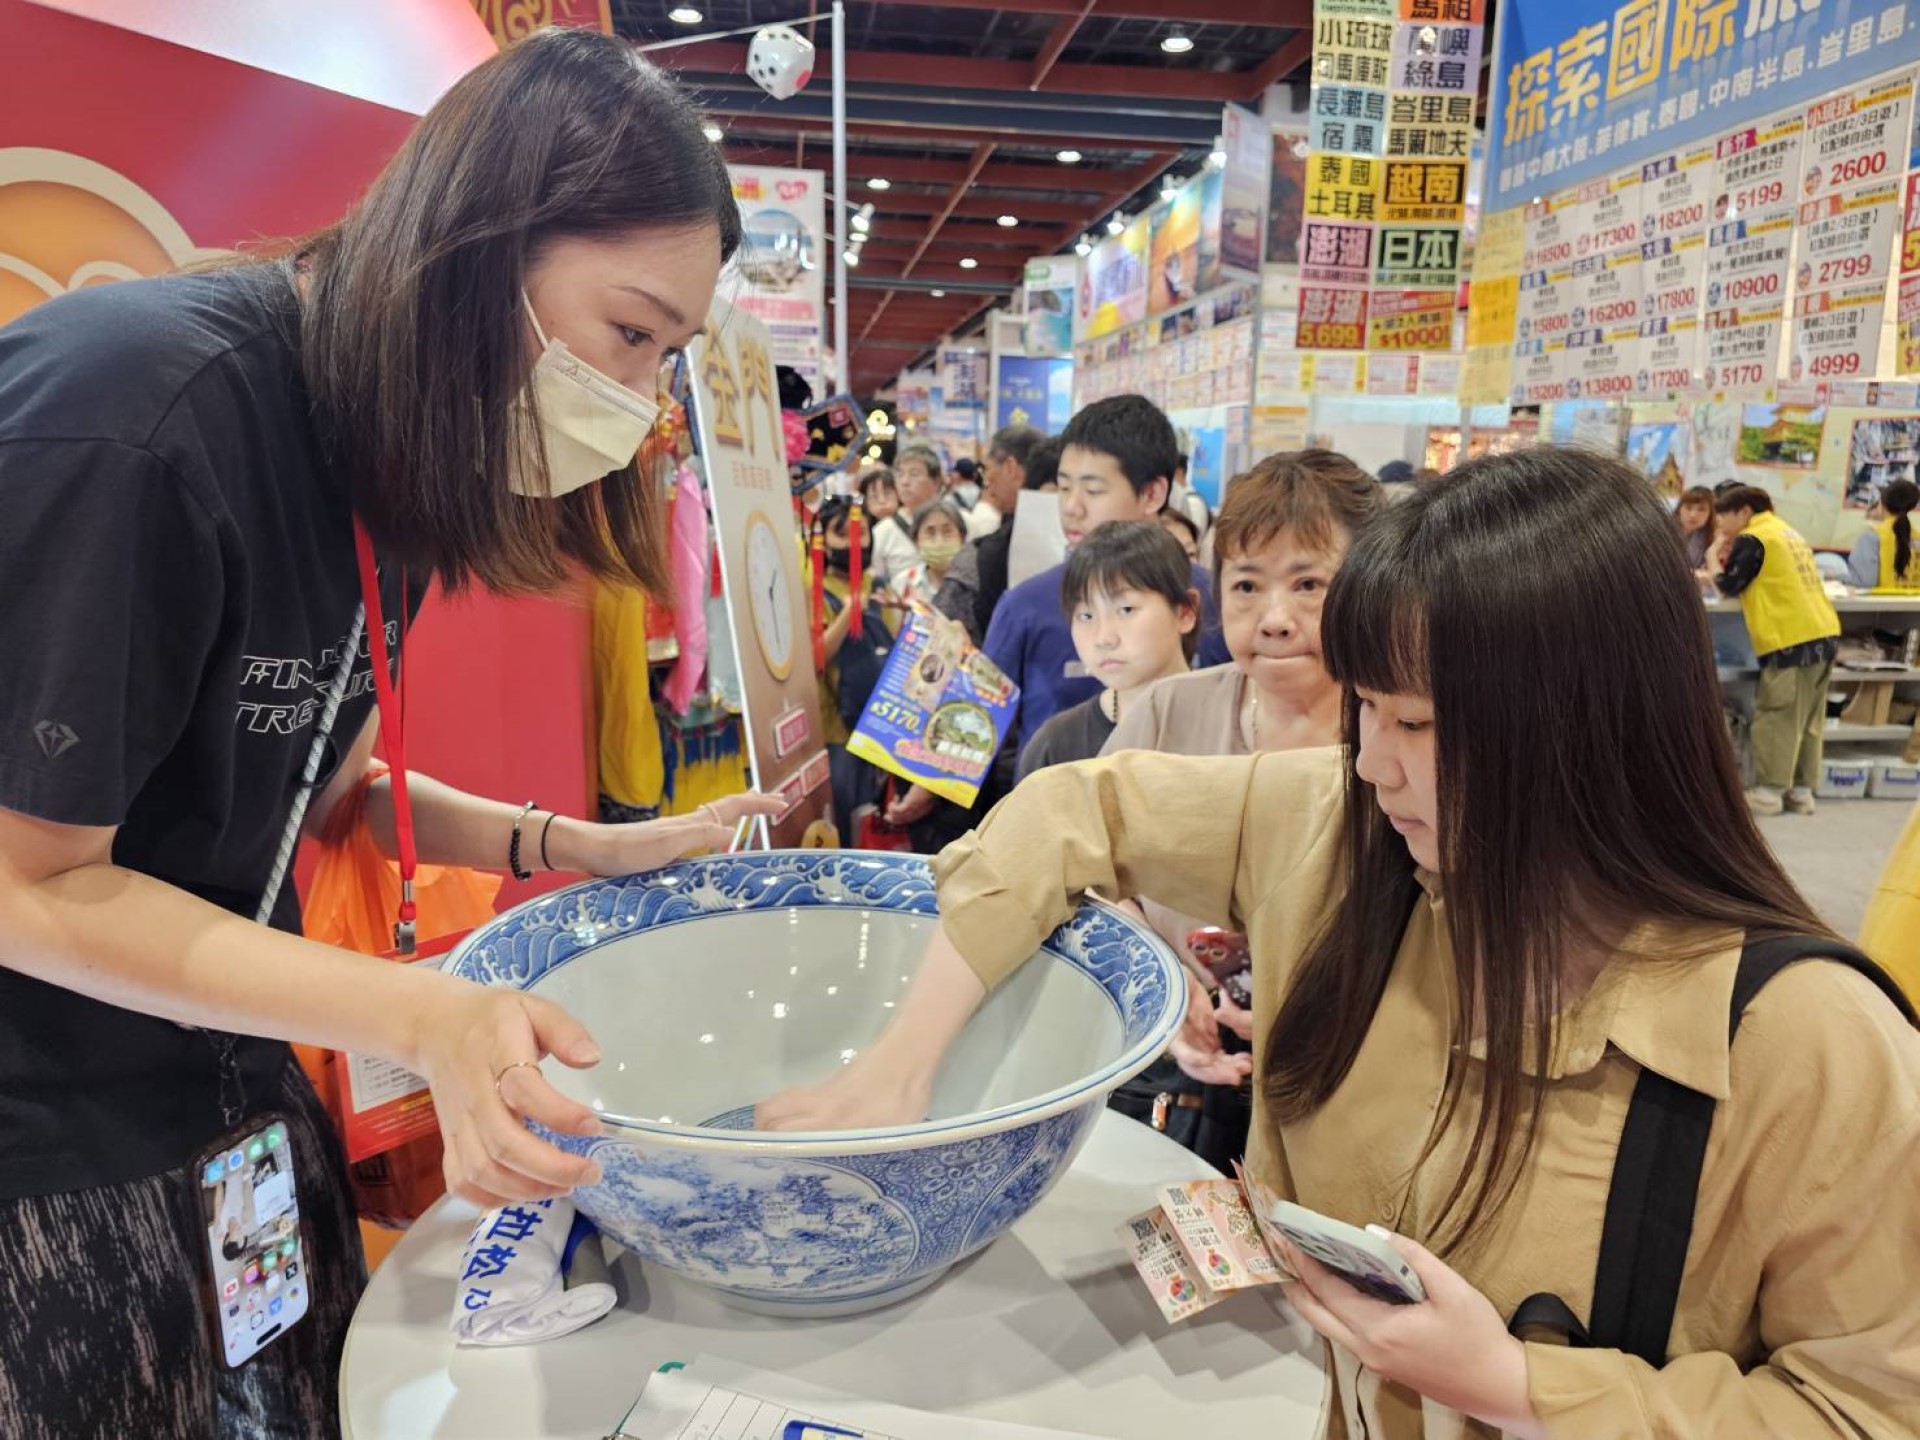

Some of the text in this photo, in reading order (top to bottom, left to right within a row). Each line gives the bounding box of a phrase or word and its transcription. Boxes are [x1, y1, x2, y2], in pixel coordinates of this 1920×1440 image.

[1318, 20, 1392, 50] 小琉球
[1316, 52, 1388, 86] 司馬庫斯
[1404, 60, 1467, 90] 綠島
[1316, 87, 1385, 122] 長灘島
[1392, 95, 1472, 124] 峇里島
[1321, 121, 1374, 153] 宿霧
[1388, 128, 1467, 157] 馬爾地夫
[1320, 156, 1371, 186] 泰國
[1387, 163, 1462, 204] 越南
[1829, 150, 1888, 187] 2600
[1308, 189, 1376, 221] 土耳其
[1736, 181, 1783, 212] 5199
[1659, 203, 1704, 231] 18200
[1307, 225, 1371, 267] 澎湖
[1383, 229, 1458, 270] 日本
[1593, 223, 1636, 249] 17300
[1818, 254, 1872, 284] 2799
[1657, 287, 1696, 311] 17800
[1724, 273, 1779, 302] 10900
[1588, 299, 1637, 325] 16200
[1652, 368, 1690, 389] 17200
[1721, 364, 1763, 386] 5170
[1809, 353, 1860, 376] 4999
[1585, 375, 1633, 395] 13800
[462, 1198, 553, 1281] 拉松
